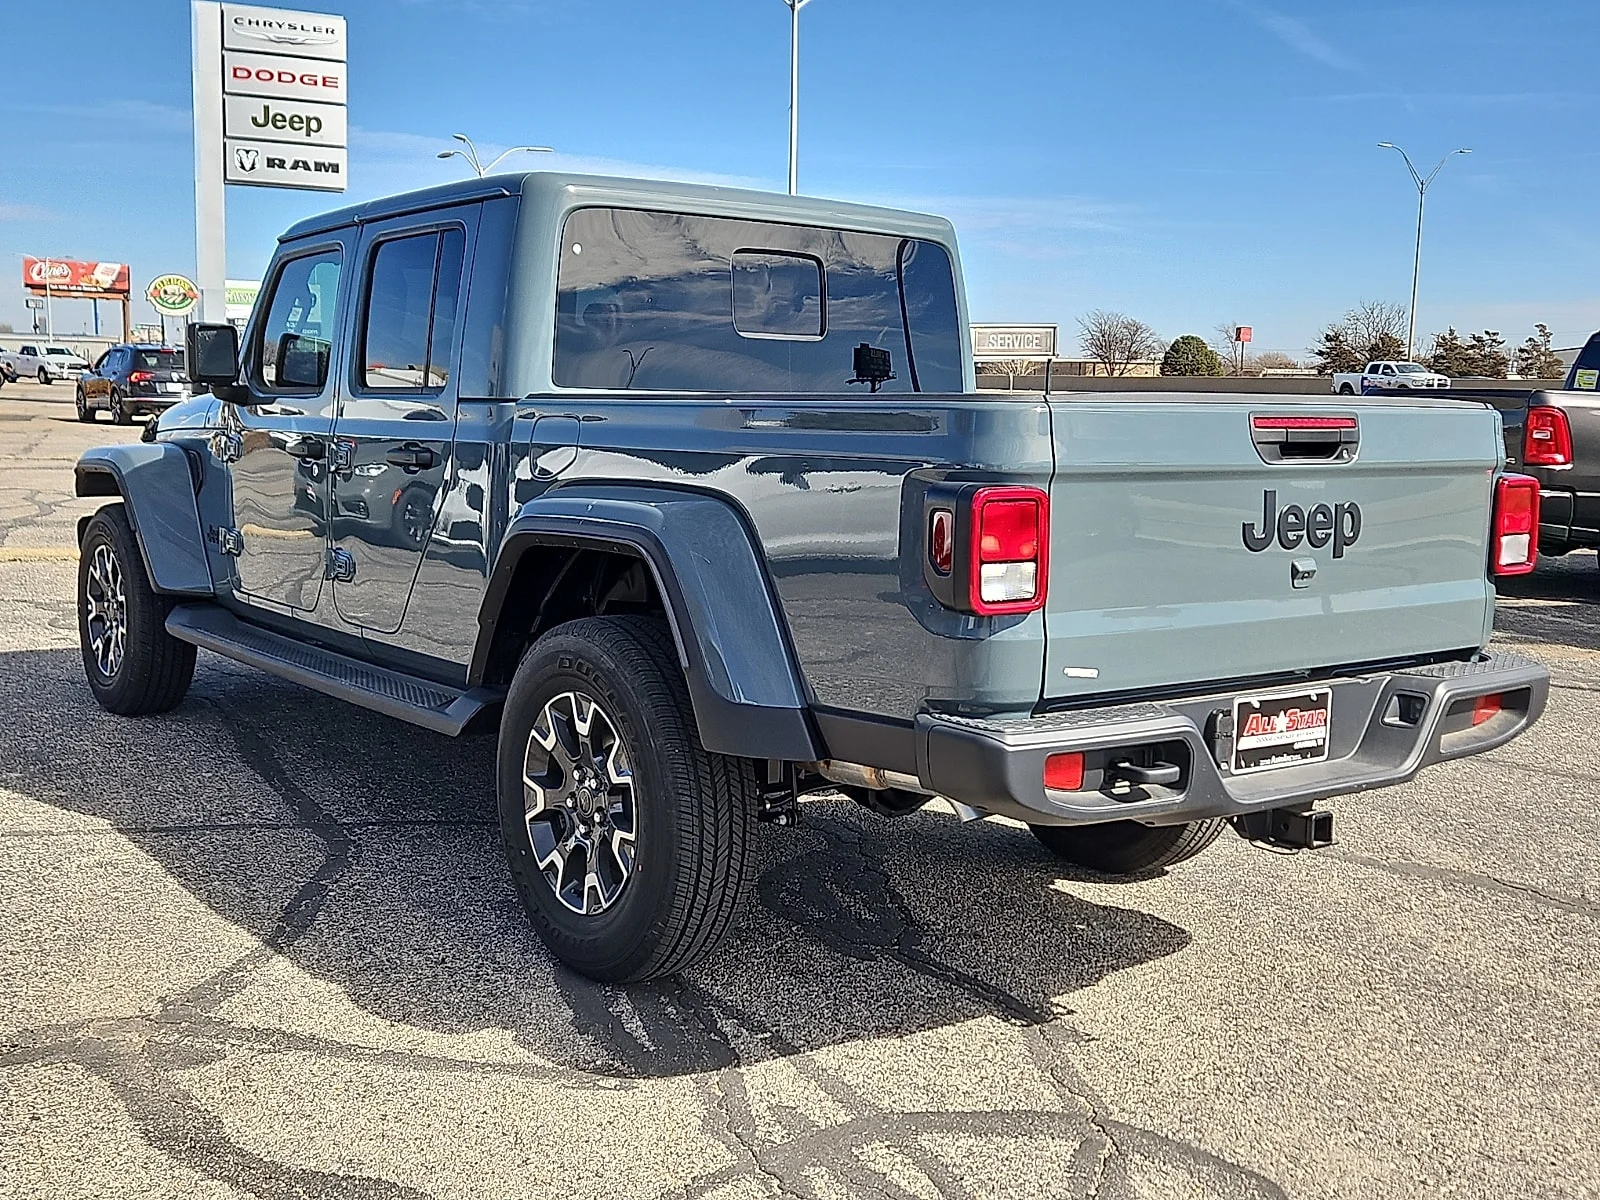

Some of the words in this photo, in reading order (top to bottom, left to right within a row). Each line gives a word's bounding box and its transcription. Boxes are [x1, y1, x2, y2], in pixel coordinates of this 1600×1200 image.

[233, 17, 336, 35] CHRYSLER
[232, 66, 339, 89] DODGE
[251, 104, 322, 137] Jeep
[266, 156, 340, 174] RAM
[988, 333, 1041, 350] SERVICE
[1242, 489, 1362, 559] Jeep
